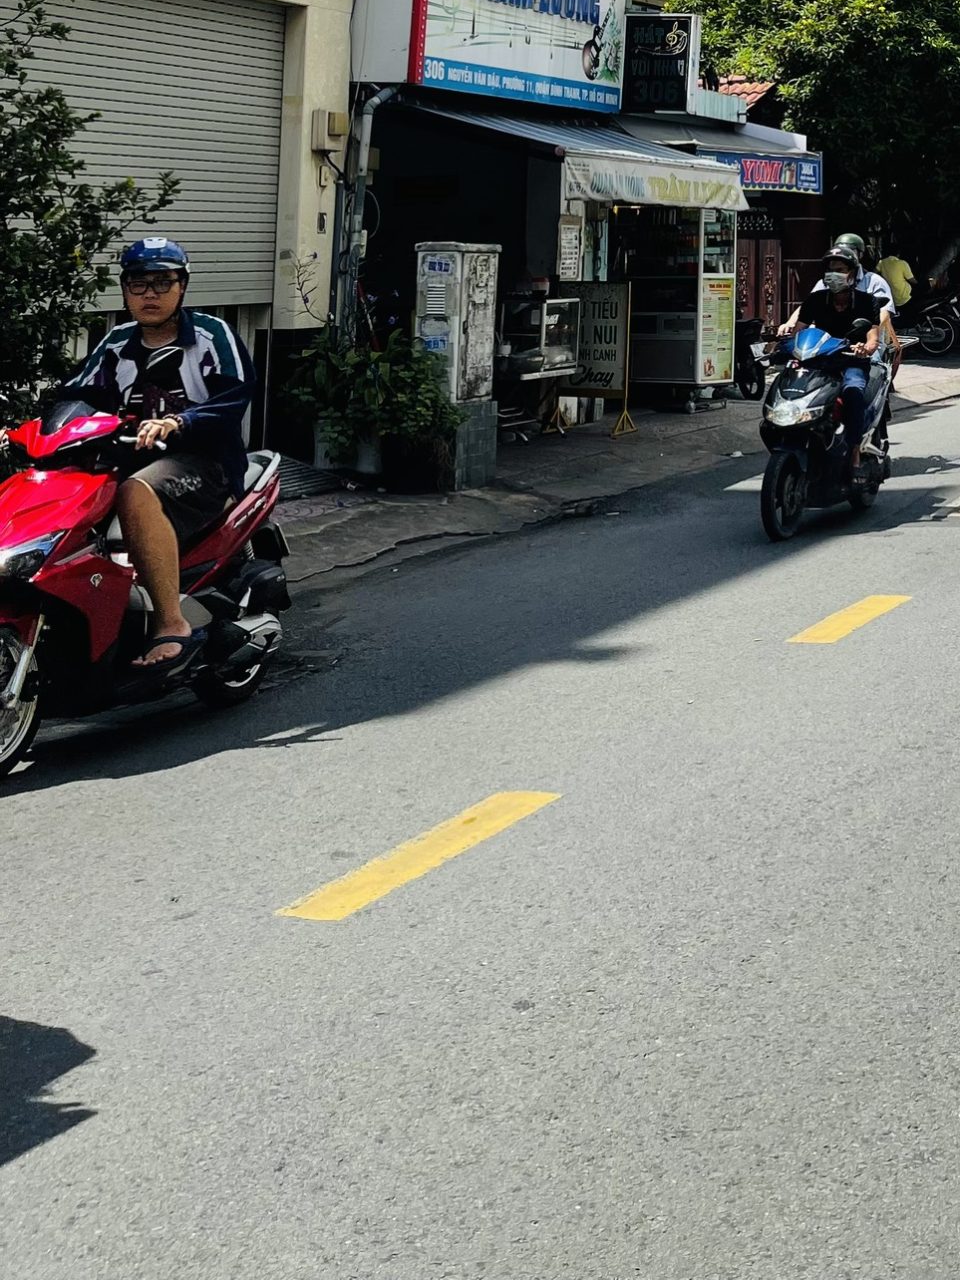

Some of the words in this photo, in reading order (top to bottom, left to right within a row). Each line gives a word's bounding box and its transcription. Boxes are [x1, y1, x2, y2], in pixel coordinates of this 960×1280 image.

[423, 58, 446, 81] 306
[742, 159, 783, 184] YUMI
[591, 295, 619, 320] TIẾU
[593, 324, 617, 345] NUI
[592, 348, 617, 361] CANH
